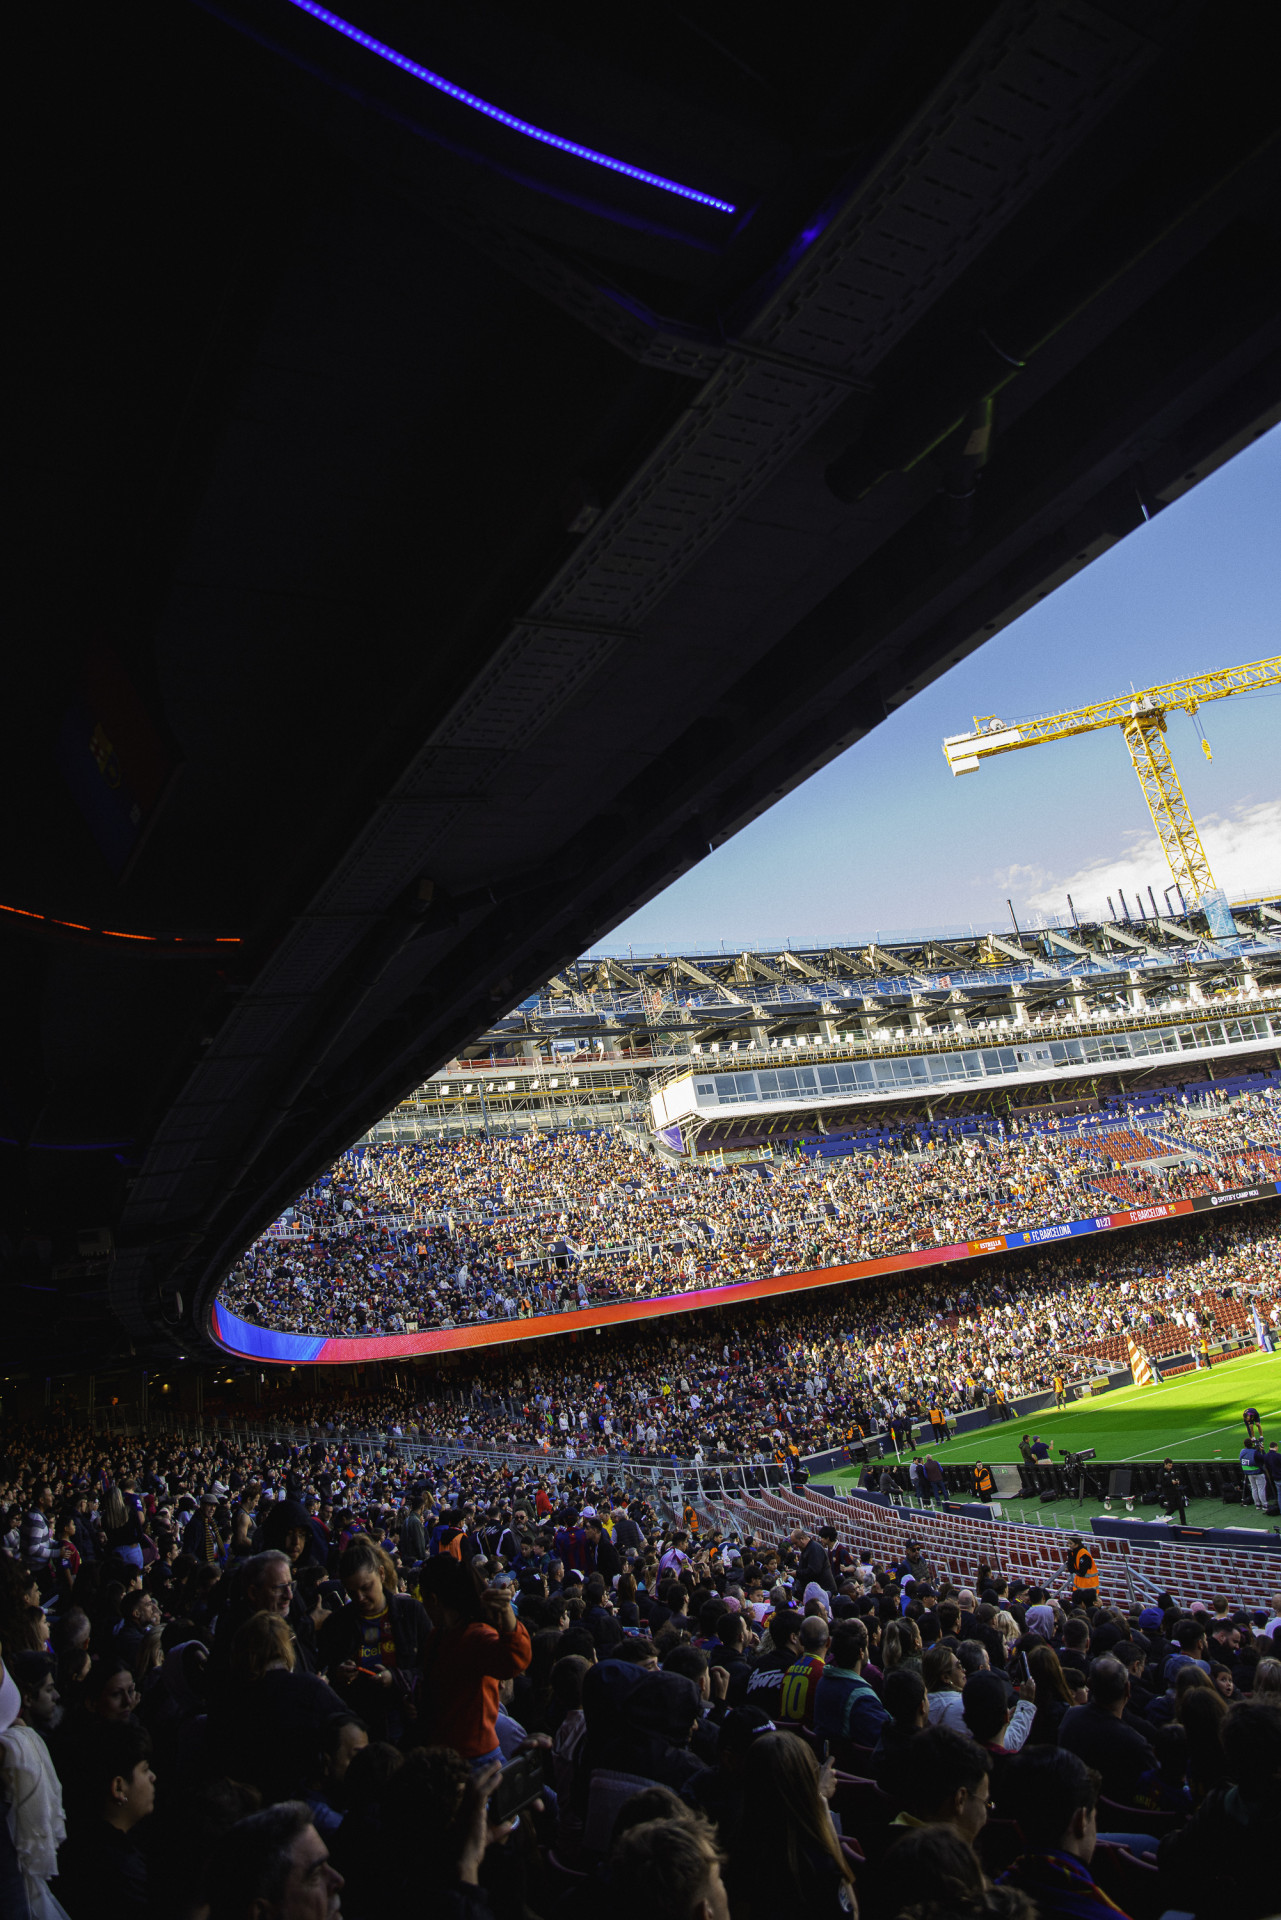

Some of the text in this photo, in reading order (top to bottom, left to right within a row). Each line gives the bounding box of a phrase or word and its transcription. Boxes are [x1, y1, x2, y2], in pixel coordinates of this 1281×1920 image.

[1217, 1189, 1259, 1203] SPOTIFY CAMP NOU
[1129, 1206, 1168, 1222] FC BARCELONA
[1095, 1217, 1111, 1228] 01:27
[1031, 1225, 1072, 1242] FC BARCELONA
[781, 1675, 809, 1719] 10
